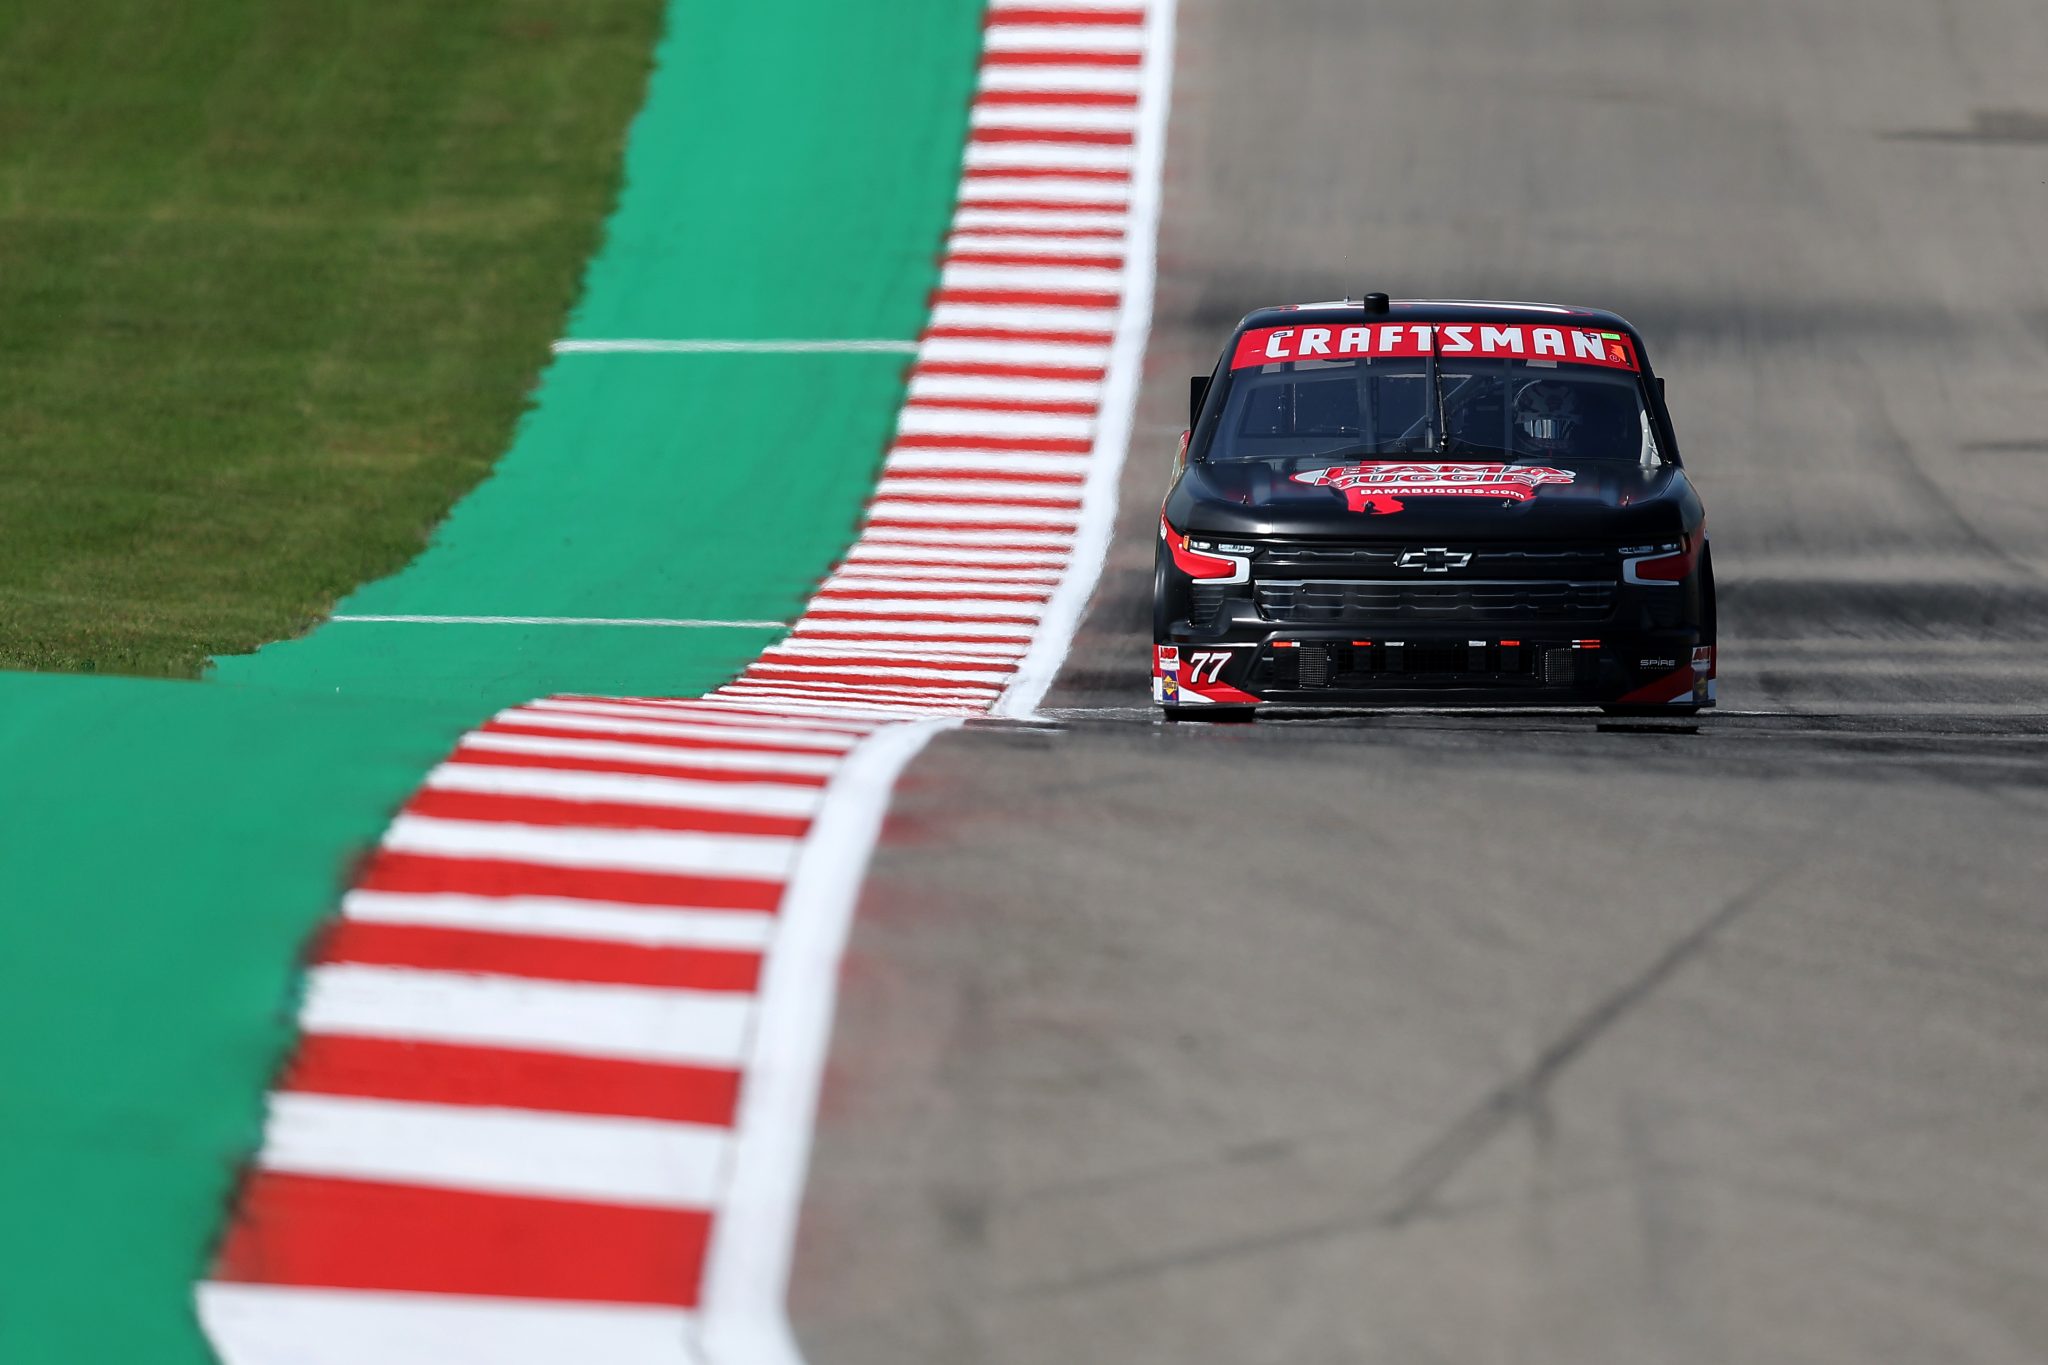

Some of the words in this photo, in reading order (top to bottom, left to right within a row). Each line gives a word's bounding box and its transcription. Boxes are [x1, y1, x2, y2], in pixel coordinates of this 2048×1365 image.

[1265, 326, 1606, 360] CRAFTSMAN
[1360, 488, 1525, 499] BAMABUGGIES.com
[1190, 652, 1232, 684] 77
[1640, 656, 1676, 666] SPIRE
